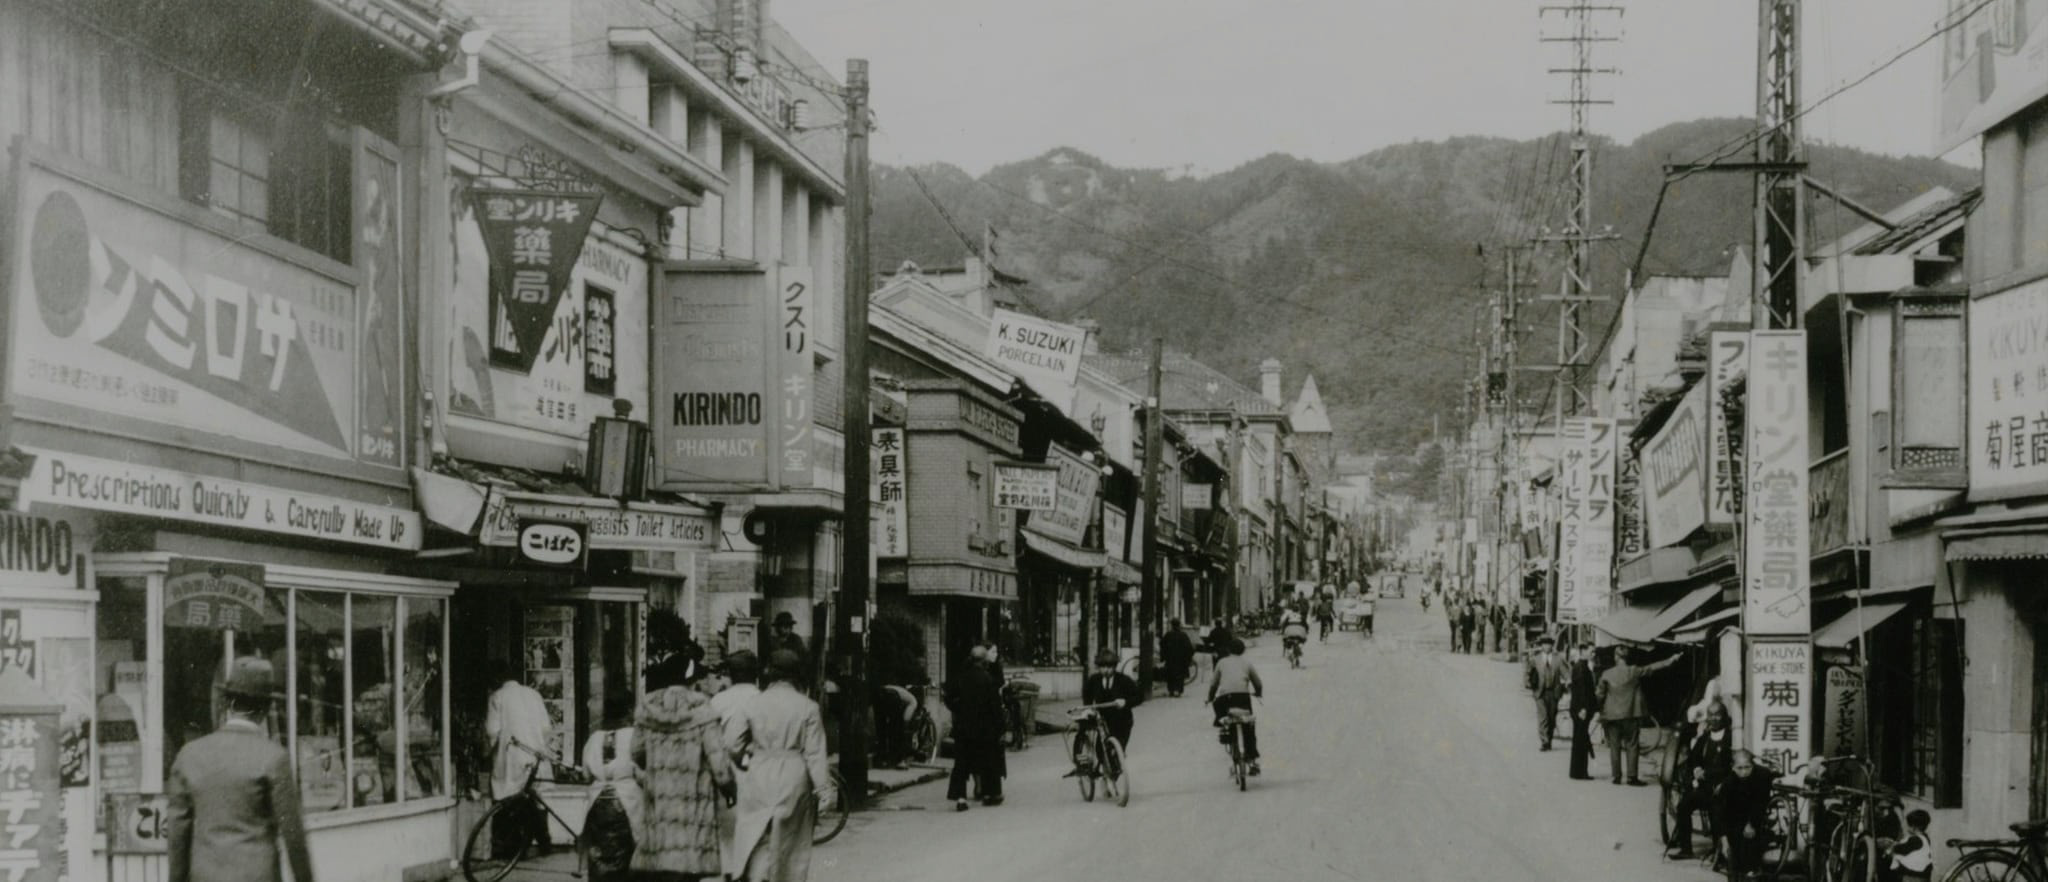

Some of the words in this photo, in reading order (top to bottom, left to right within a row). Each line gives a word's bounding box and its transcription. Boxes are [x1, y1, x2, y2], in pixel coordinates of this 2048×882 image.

[486, 199, 580, 223] キリン堂
[583, 246, 630, 284] HARMACY
[785, 282, 805, 353] クスリ
[1016, 328, 1075, 354] SUZUKI
[999, 345, 1065, 372] PORCELAIN
[673, 393, 761, 426] KIRINDO
[784, 375, 806, 472] キリン堂
[676, 439, 758, 458] PHARMACY
[879, 432, 902, 502] 表具師
[51, 459, 182, 511] Prescriptions
[193, 481, 250, 521] Quickly
[265, 498, 275, 524] &
[288, 497, 346, 535] Carefully
[353, 507, 382, 540] Made
[390, 514, 405, 543] Up
[636, 514, 663, 536] Toilet
[670, 518, 705, 541] Articles
[1755, 647, 1805, 658] KIKUYA
[1753, 663, 1776, 674] SHOE
[1781, 663, 1805, 674] STORE
